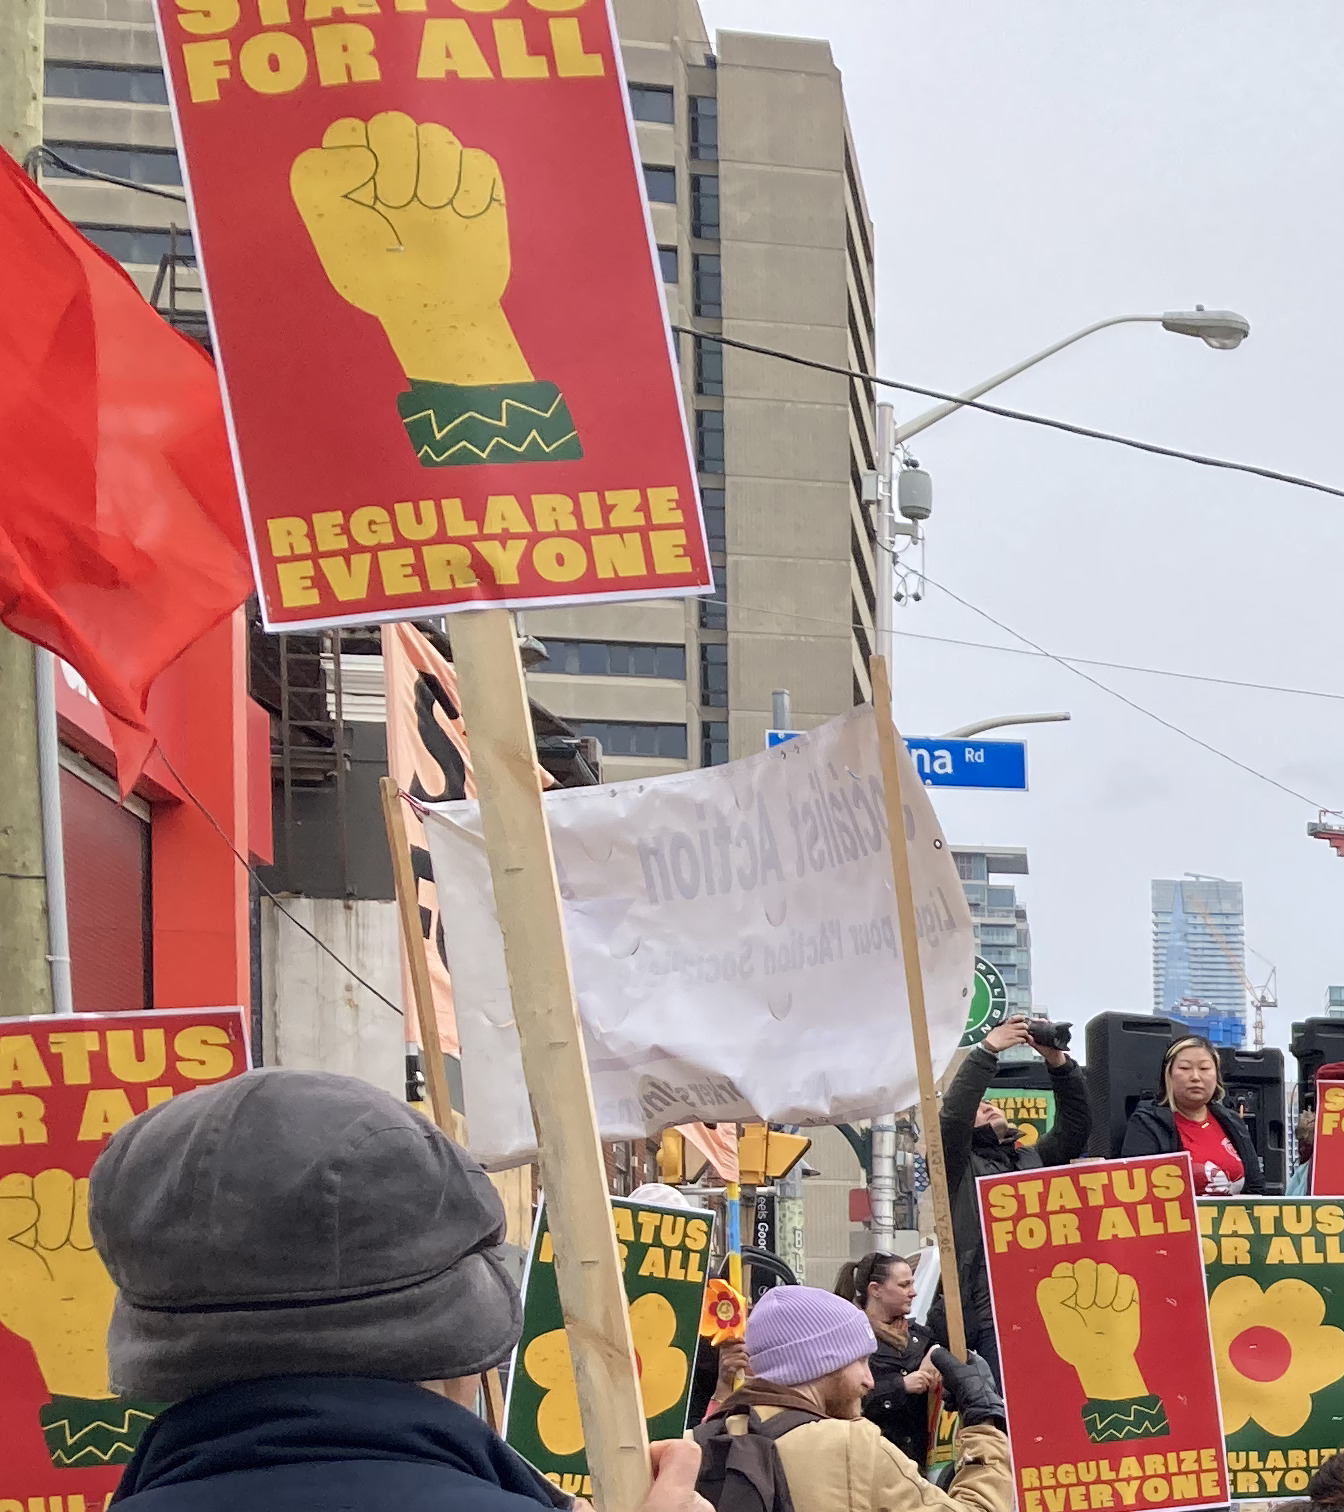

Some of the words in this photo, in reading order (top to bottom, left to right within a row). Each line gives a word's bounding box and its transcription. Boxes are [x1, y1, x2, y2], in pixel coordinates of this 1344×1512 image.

[182, 22, 381, 102] FOR
[416, 17, 605, 79] ALL
[267, 486, 684, 557] REGULARIZE
[277, 529, 692, 608] EVERYONE
[964, 747, 985, 763] Rd
[0, 1025, 234, 1088] ATUS
[988, 1164, 1186, 1219] STATUS
[612, 1207, 708, 1251] ATUS
[991, 1213, 1081, 1253] FOR
[1097, 1200, 1192, 1241] ALL
[638, 1246, 704, 1283] ALL
[1020, 1447, 1218, 1489] REGULARIZE
